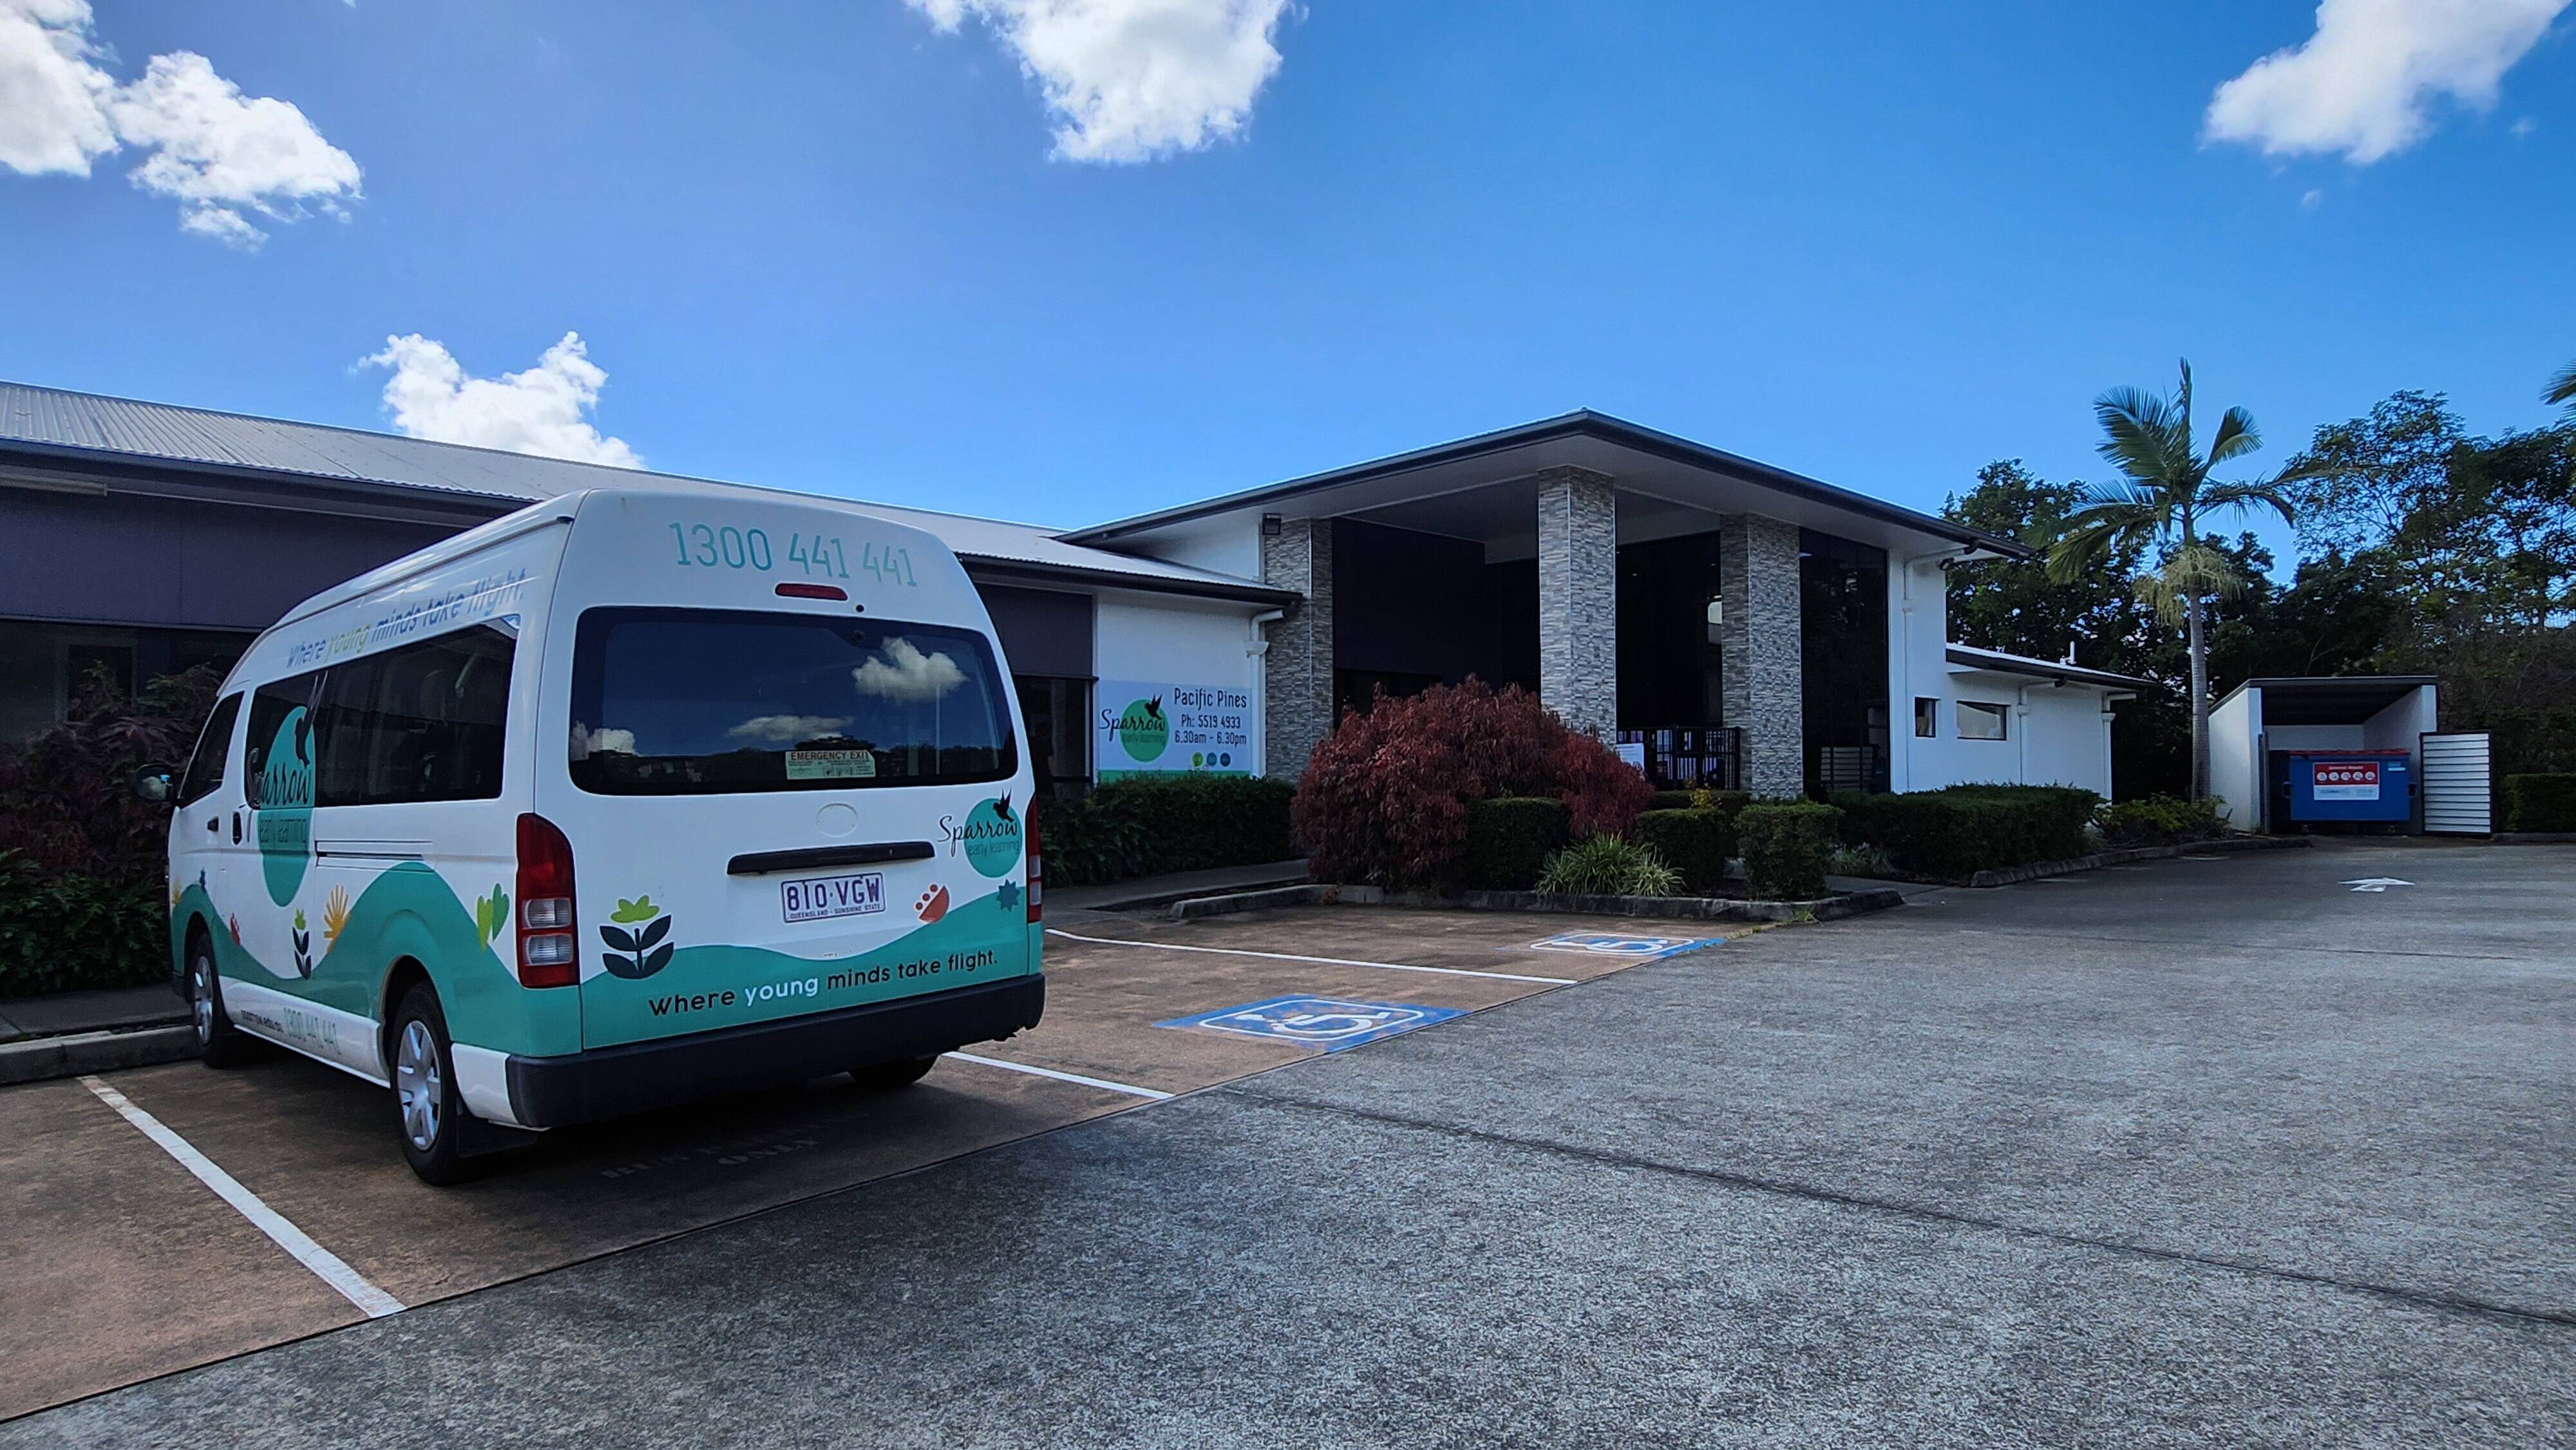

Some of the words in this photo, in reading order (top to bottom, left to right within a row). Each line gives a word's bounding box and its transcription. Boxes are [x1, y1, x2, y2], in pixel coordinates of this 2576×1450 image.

[668, 522, 773, 571] 1300
[788, 532, 850, 579] 441
[863, 542, 917, 587] 441
[324, 623, 372, 664] young
[371, 603, 421, 644] minds
[422, 591, 466, 628] take
[1174, 687, 1213, 711] Pacific
[1217, 690, 1247, 709] Pines
[1098, 708, 1166, 742] Sparrow
[1181, 714, 1195, 728] Ph:
[1198, 715, 1218, 728] 5519
[1220, 715, 1241, 729] 4933
[1175, 730, 1207, 744] 6.30am
[1217, 731, 1247, 747] 6.30pm
[790, 751, 847, 760] EMERGENCY
[850, 750, 869, 760] EXIT
[937, 814, 1018, 858] Sparrow
[790, 909, 829, 920] QUEENSLAND
[833, 905, 863, 914] SUNSHINE
[864, 903, 882, 911] STATE
[649, 990, 735, 1017] Where
[744, 977, 820, 1006] young
[826, 965, 891, 990] minds
[897, 958, 942, 979] take
[947, 949, 999, 972] flight.
